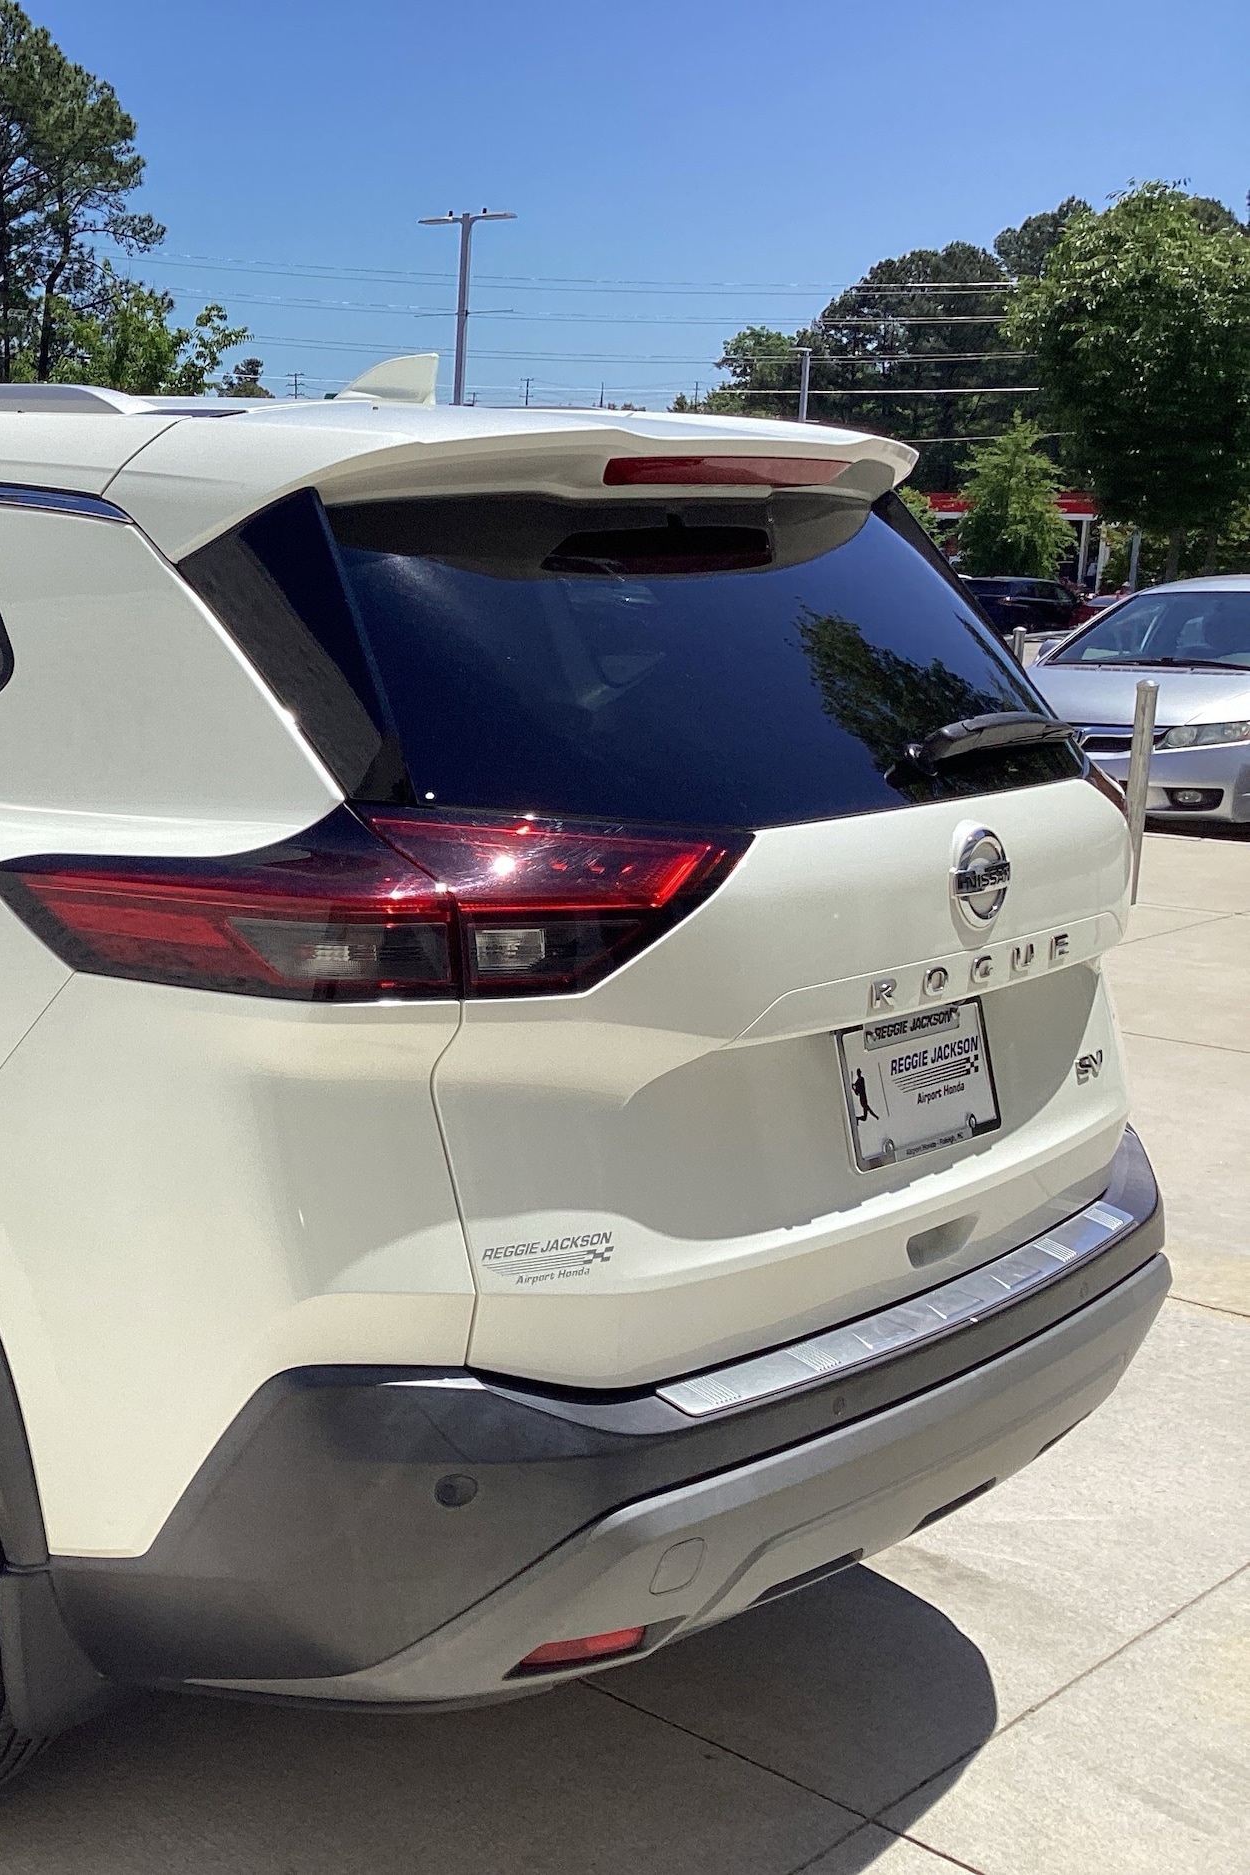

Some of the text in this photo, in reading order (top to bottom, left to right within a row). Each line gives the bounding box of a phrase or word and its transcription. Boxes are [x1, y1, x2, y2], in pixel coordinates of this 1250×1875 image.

[870, 933, 1070, 1010] ROGUE
[874, 1010, 953, 1041] REGGIE JACKSON
[891, 1035, 979, 1076] REGGIE JACKSON
[917, 1081, 965, 1105] Airport Honda
[482, 1231, 613, 1261] REGGIE JACKSON
[515, 1266, 590, 1286] Airport Honda
